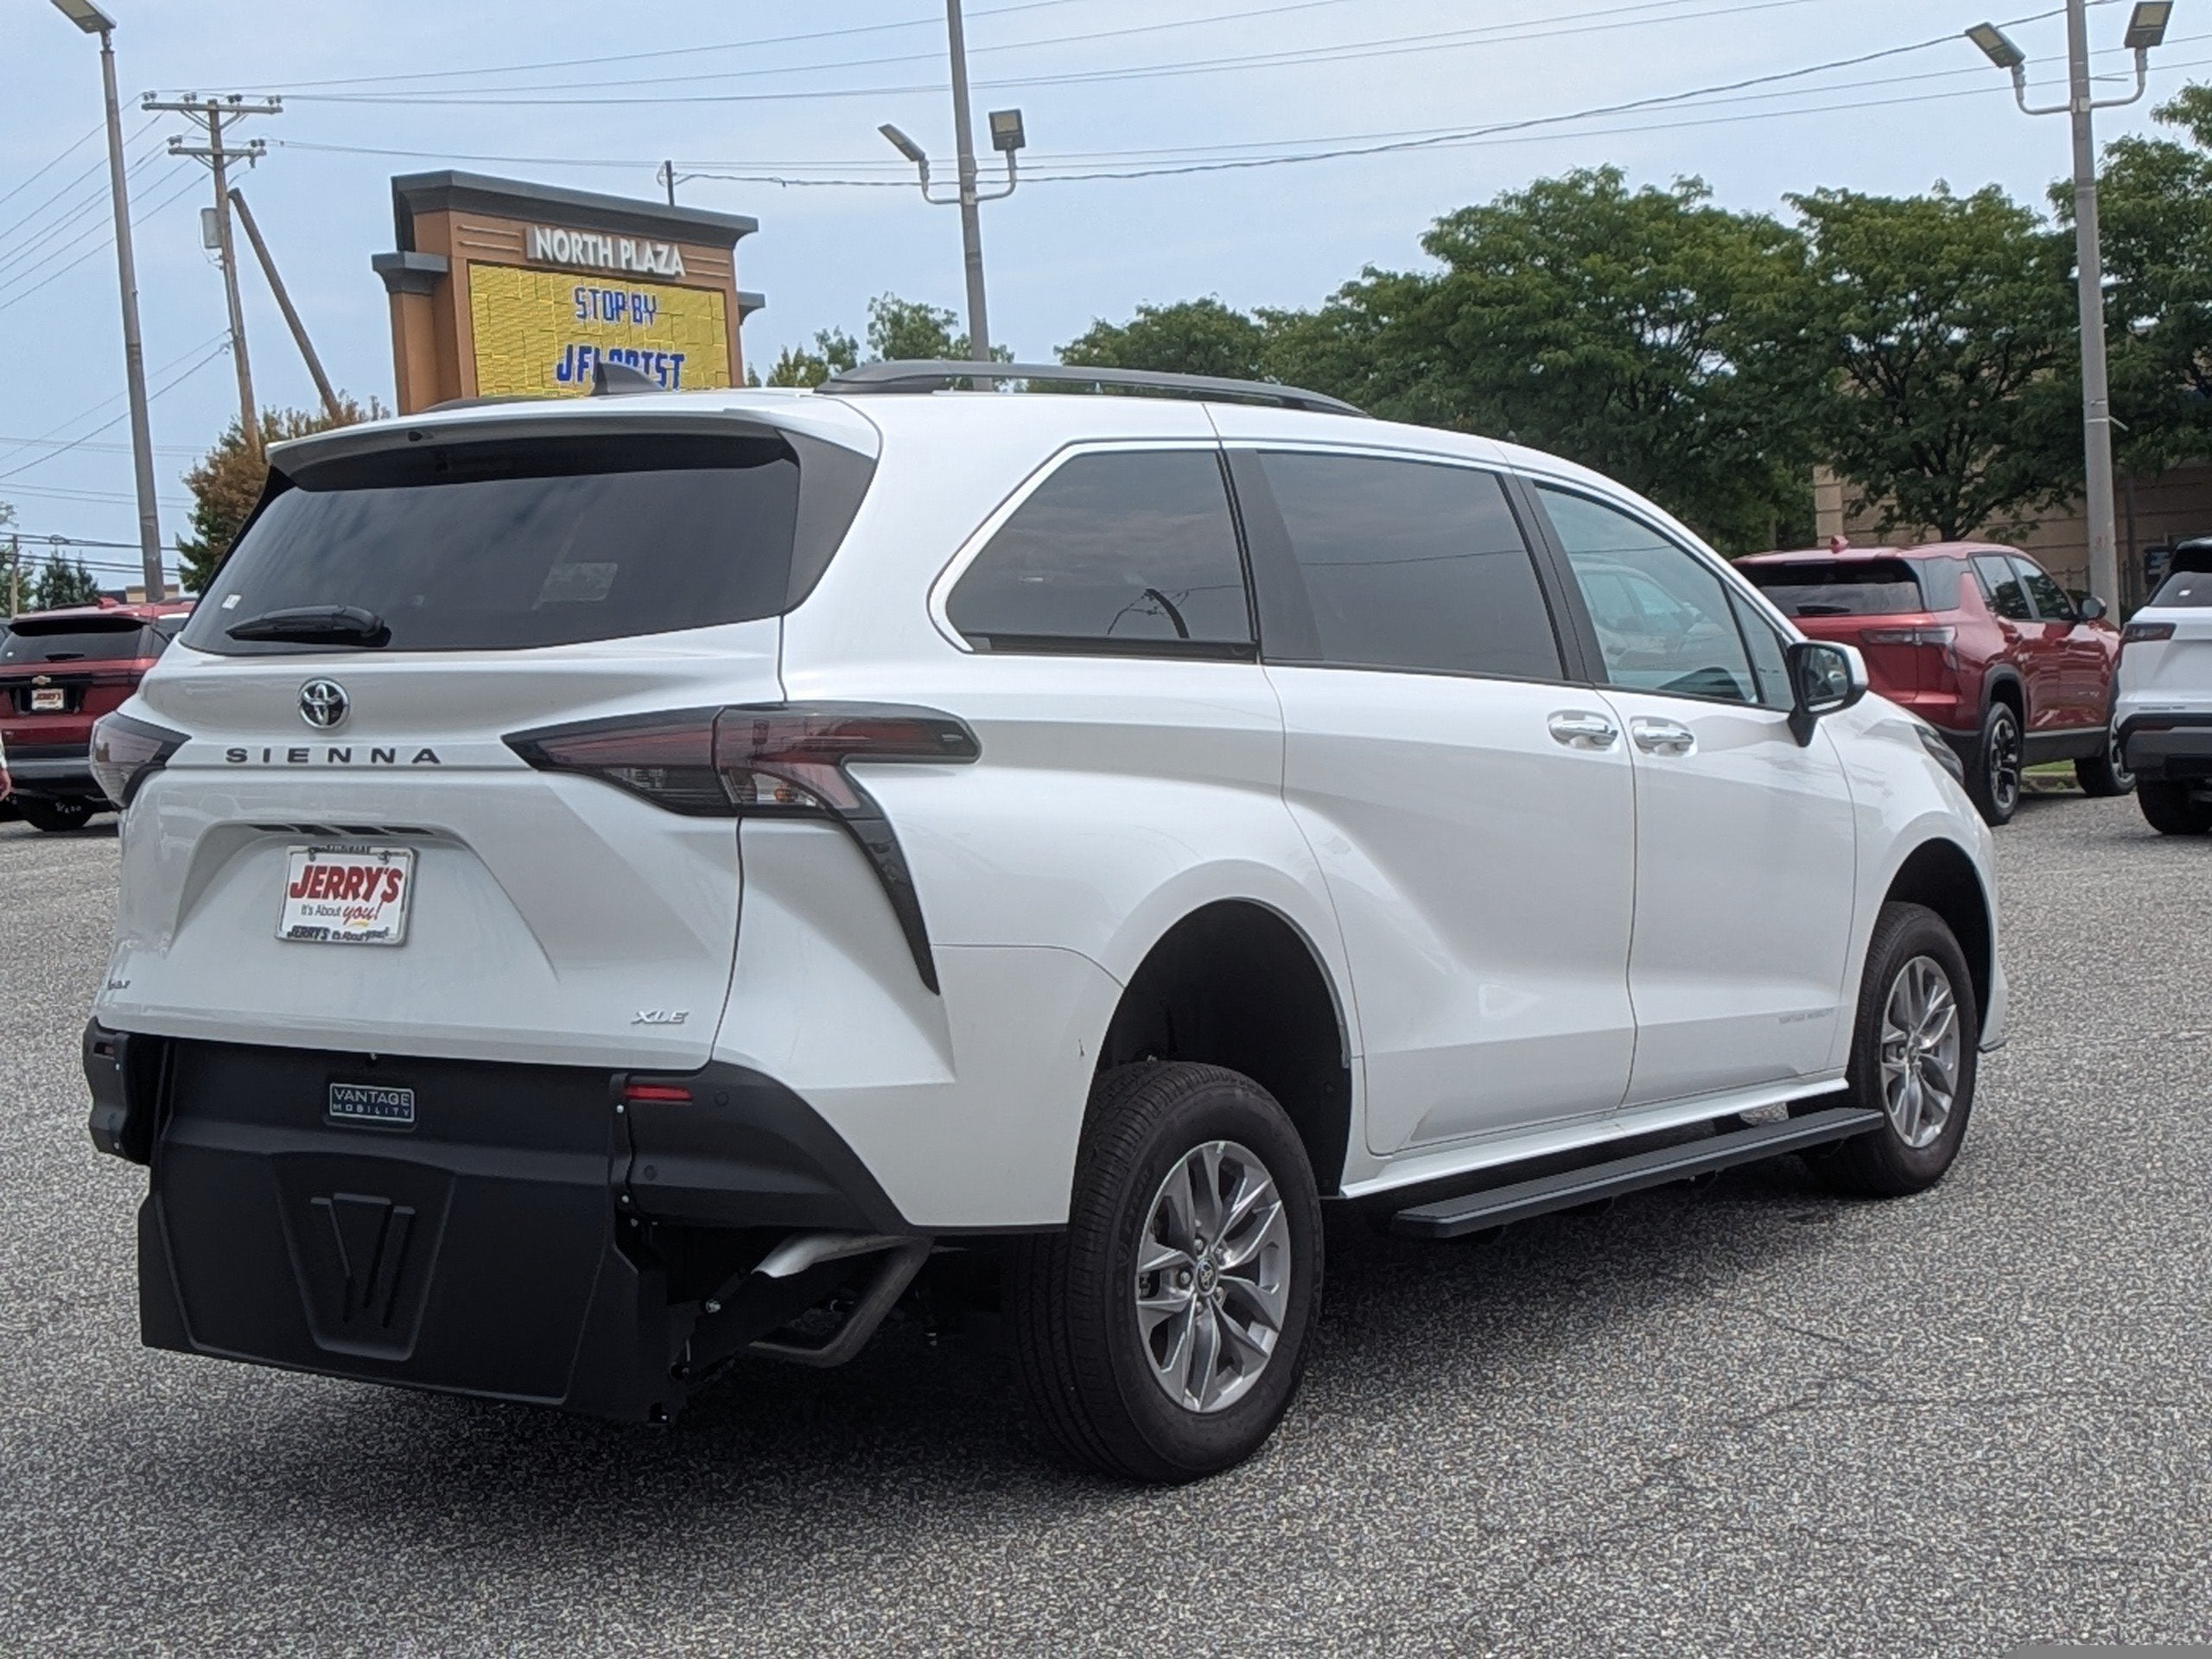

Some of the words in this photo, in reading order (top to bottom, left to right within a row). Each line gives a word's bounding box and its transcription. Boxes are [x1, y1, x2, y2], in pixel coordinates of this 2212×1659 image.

[534, 225, 614, 269] NORTH
[619, 237, 687, 277] PLAZA
[574, 286, 626, 323] STOP
[631, 292, 657, 327] BY
[225, 747, 442, 765] SIENNA
[289, 864, 404, 904] JERRY'S
[631, 1009, 690, 1025] XLE
[334, 1088, 410, 1107] VANTAGE
[333, 1103, 410, 1116] MOBILITY
